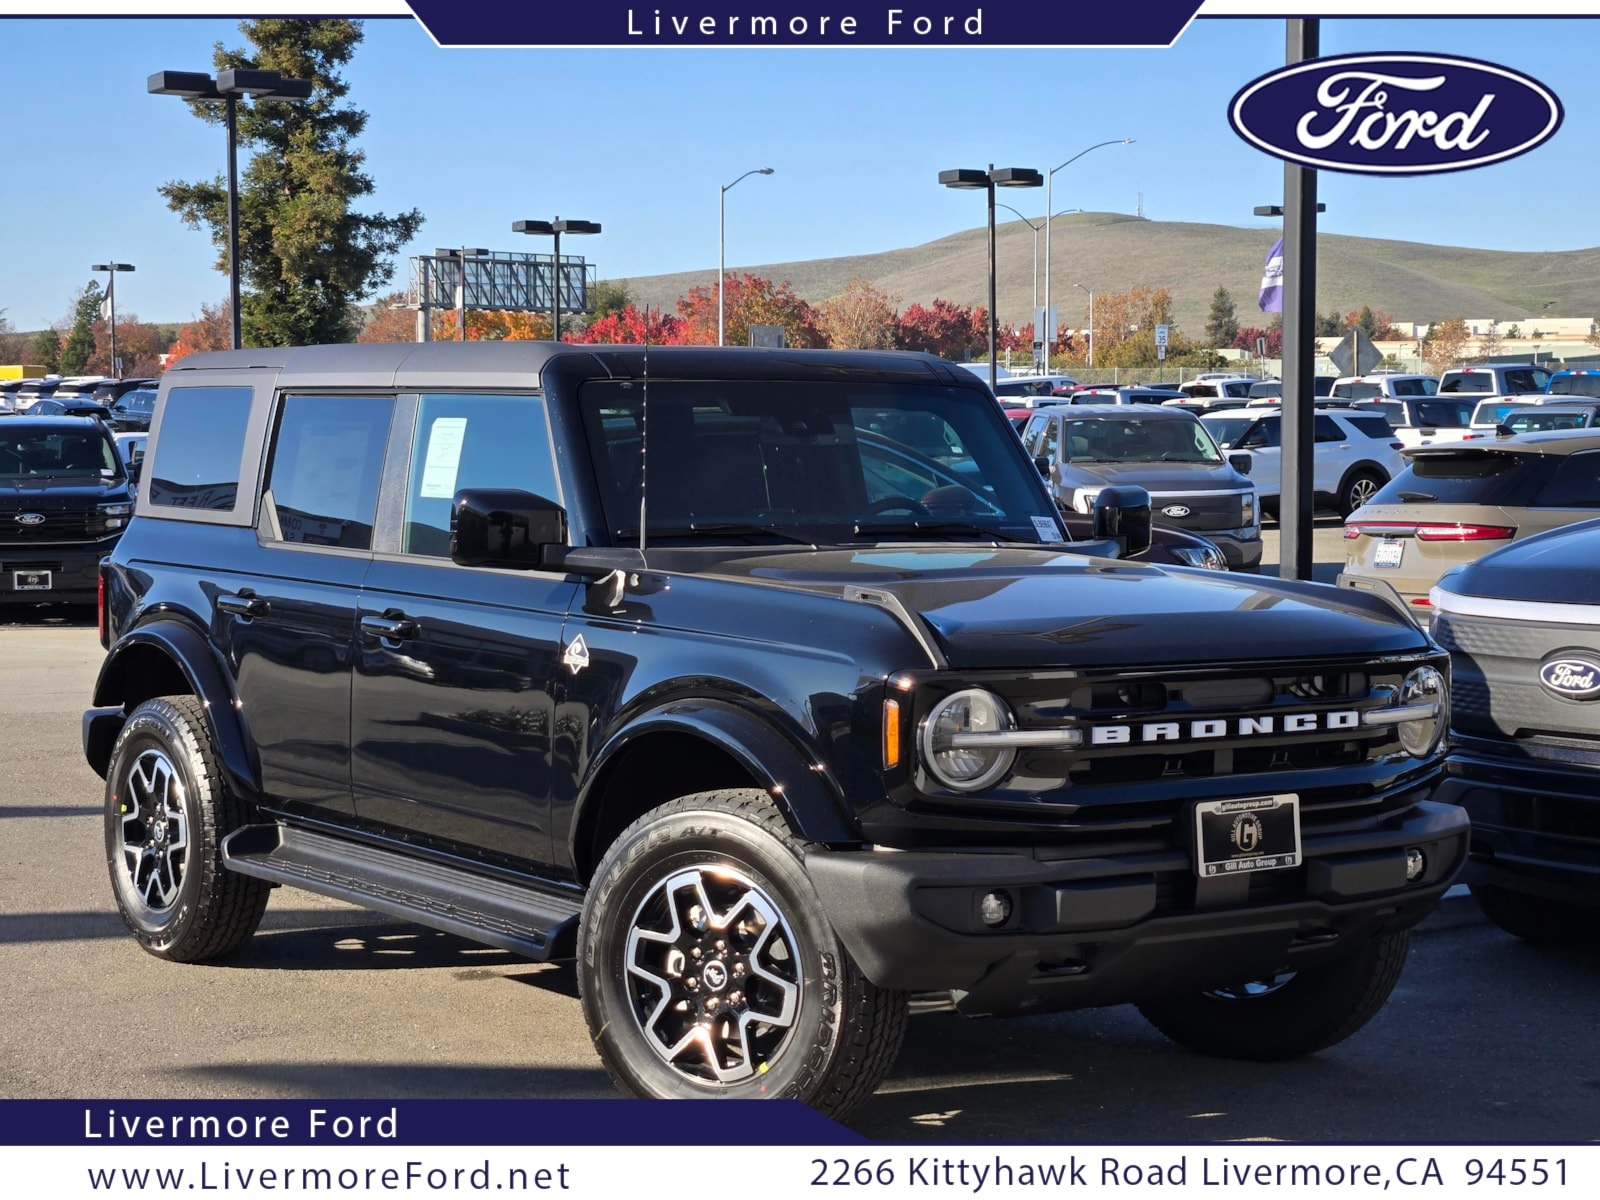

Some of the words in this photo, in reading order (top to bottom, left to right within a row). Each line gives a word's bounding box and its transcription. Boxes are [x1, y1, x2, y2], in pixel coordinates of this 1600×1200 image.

[1157, 336, 1166, 344] 35
[1550, 663, 1595, 689] Ford
[1091, 710, 1359, 745] BRONCO
[1224, 861, 1238, 871] Gill
[1238, 860, 1255, 870] Auto
[1255, 858, 1277, 868] Group
